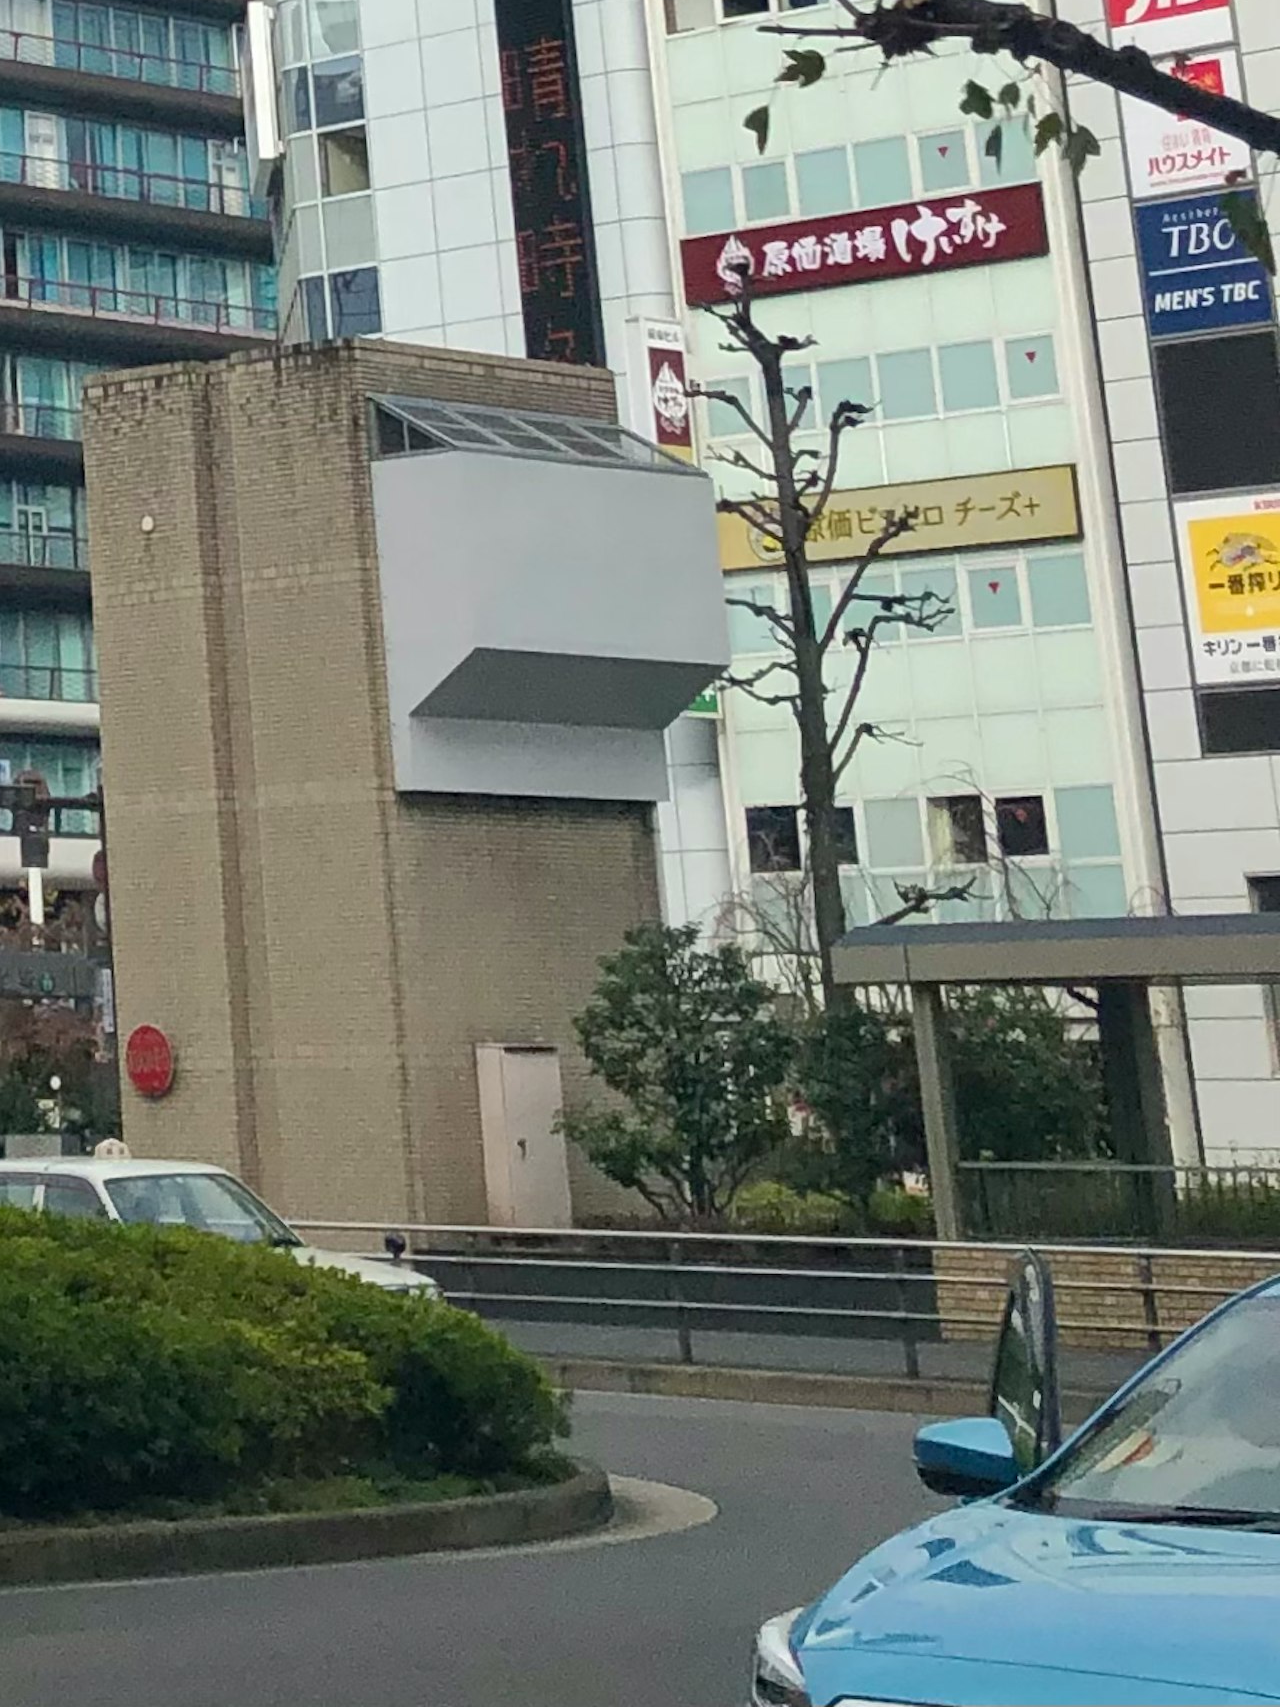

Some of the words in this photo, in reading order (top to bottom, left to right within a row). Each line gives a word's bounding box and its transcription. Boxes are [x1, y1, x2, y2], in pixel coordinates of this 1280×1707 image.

[1148, 146, 1231, 176] ハウスメイト
[1161, 218, 1236, 258] TBC
[1154, 286, 1216, 314] MEN'S
[1220, 280, 1262, 303] TBC
[1203, 635, 1280, 657] キリン一番
